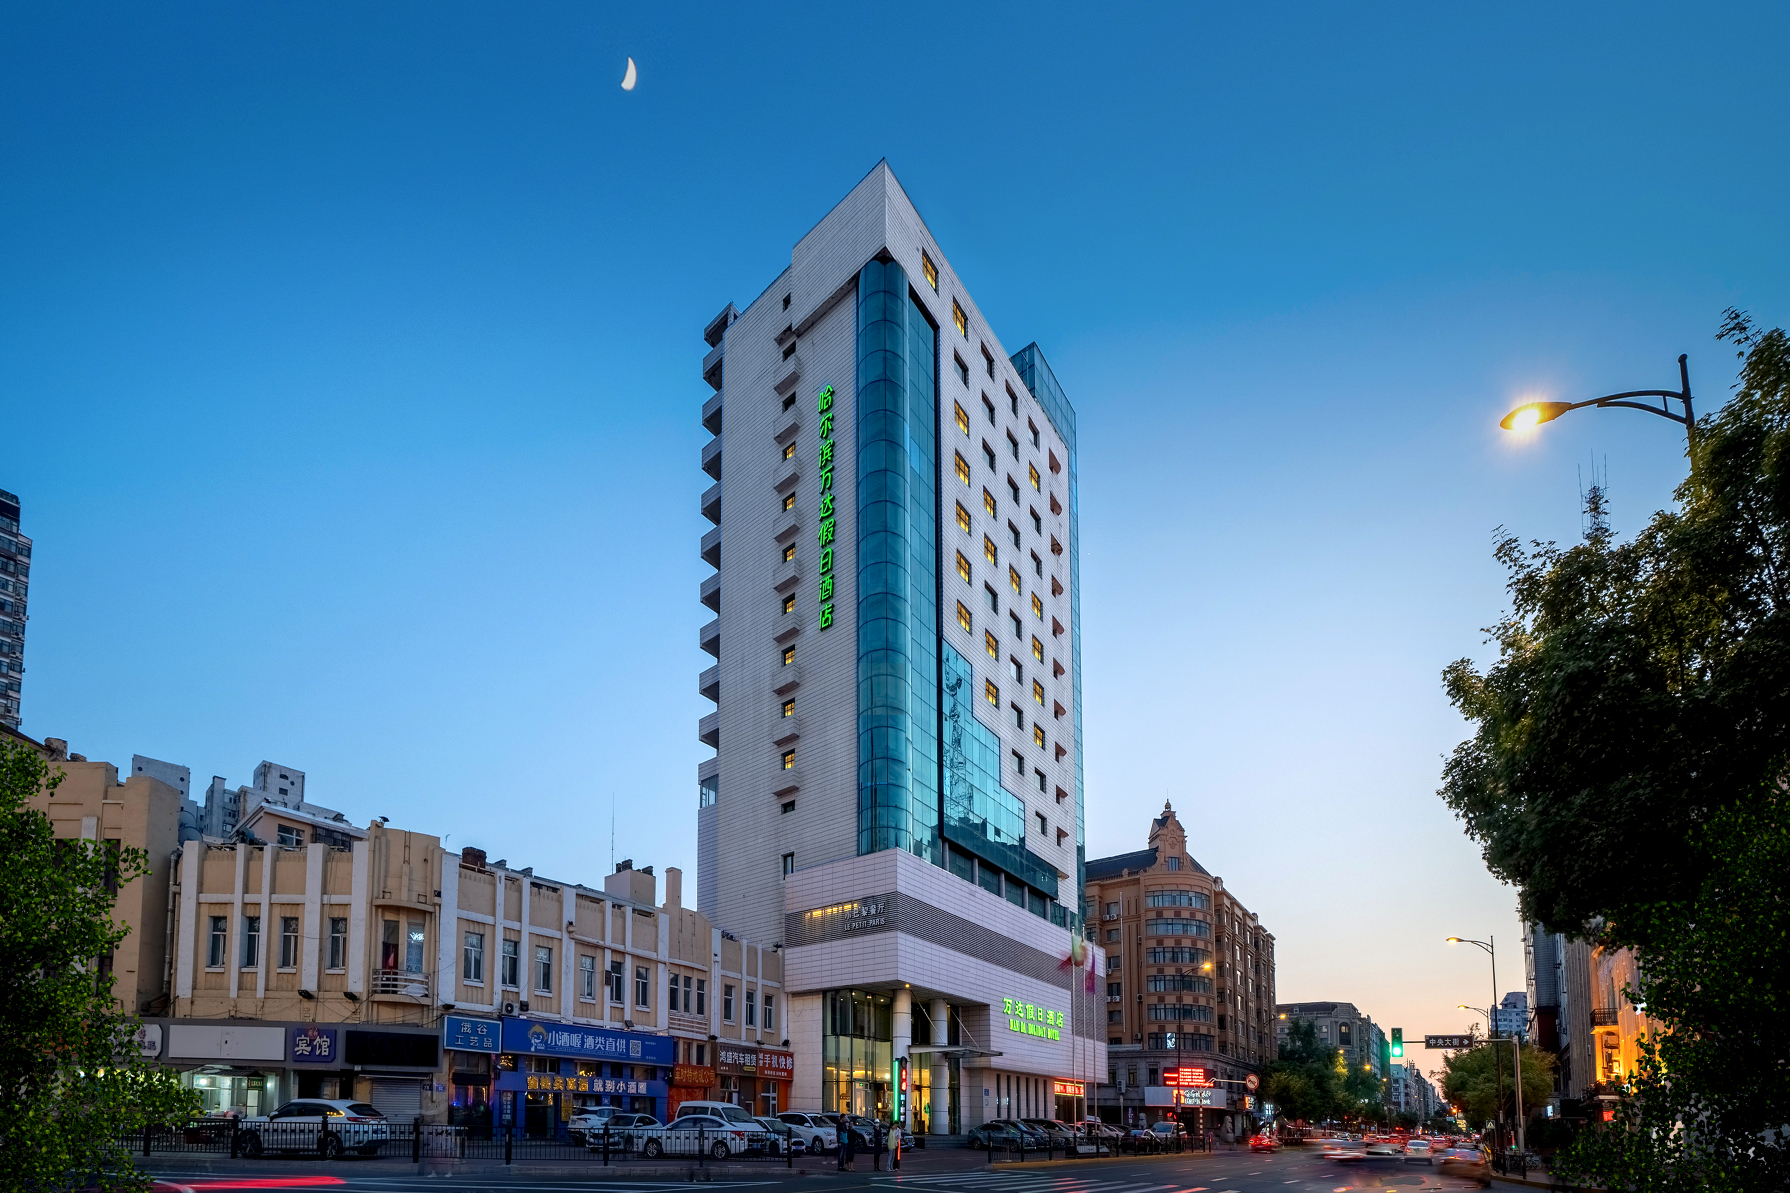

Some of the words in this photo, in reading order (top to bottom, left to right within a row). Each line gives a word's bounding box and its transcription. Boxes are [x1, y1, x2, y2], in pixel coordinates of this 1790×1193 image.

[818, 384, 835, 631] 哈尔滨万达假日酒店
[845, 902, 885, 920] 小巴黎餐厅
[845, 923, 851, 931] LE
[869, 917, 886, 927] PARIS
[1003, 997, 1064, 1028] 万达假日酒店
[294, 1034, 331, 1056] 宾馆
[454, 1034, 493, 1048] 工艺品
[583, 1034, 627, 1053] 酒类直供
[1429, 1038, 1459, 1046] 中央大街
[719, 1050, 757, 1067] 鸿盛汽车租赁
[763, 1053, 793, 1070] 手机快修
